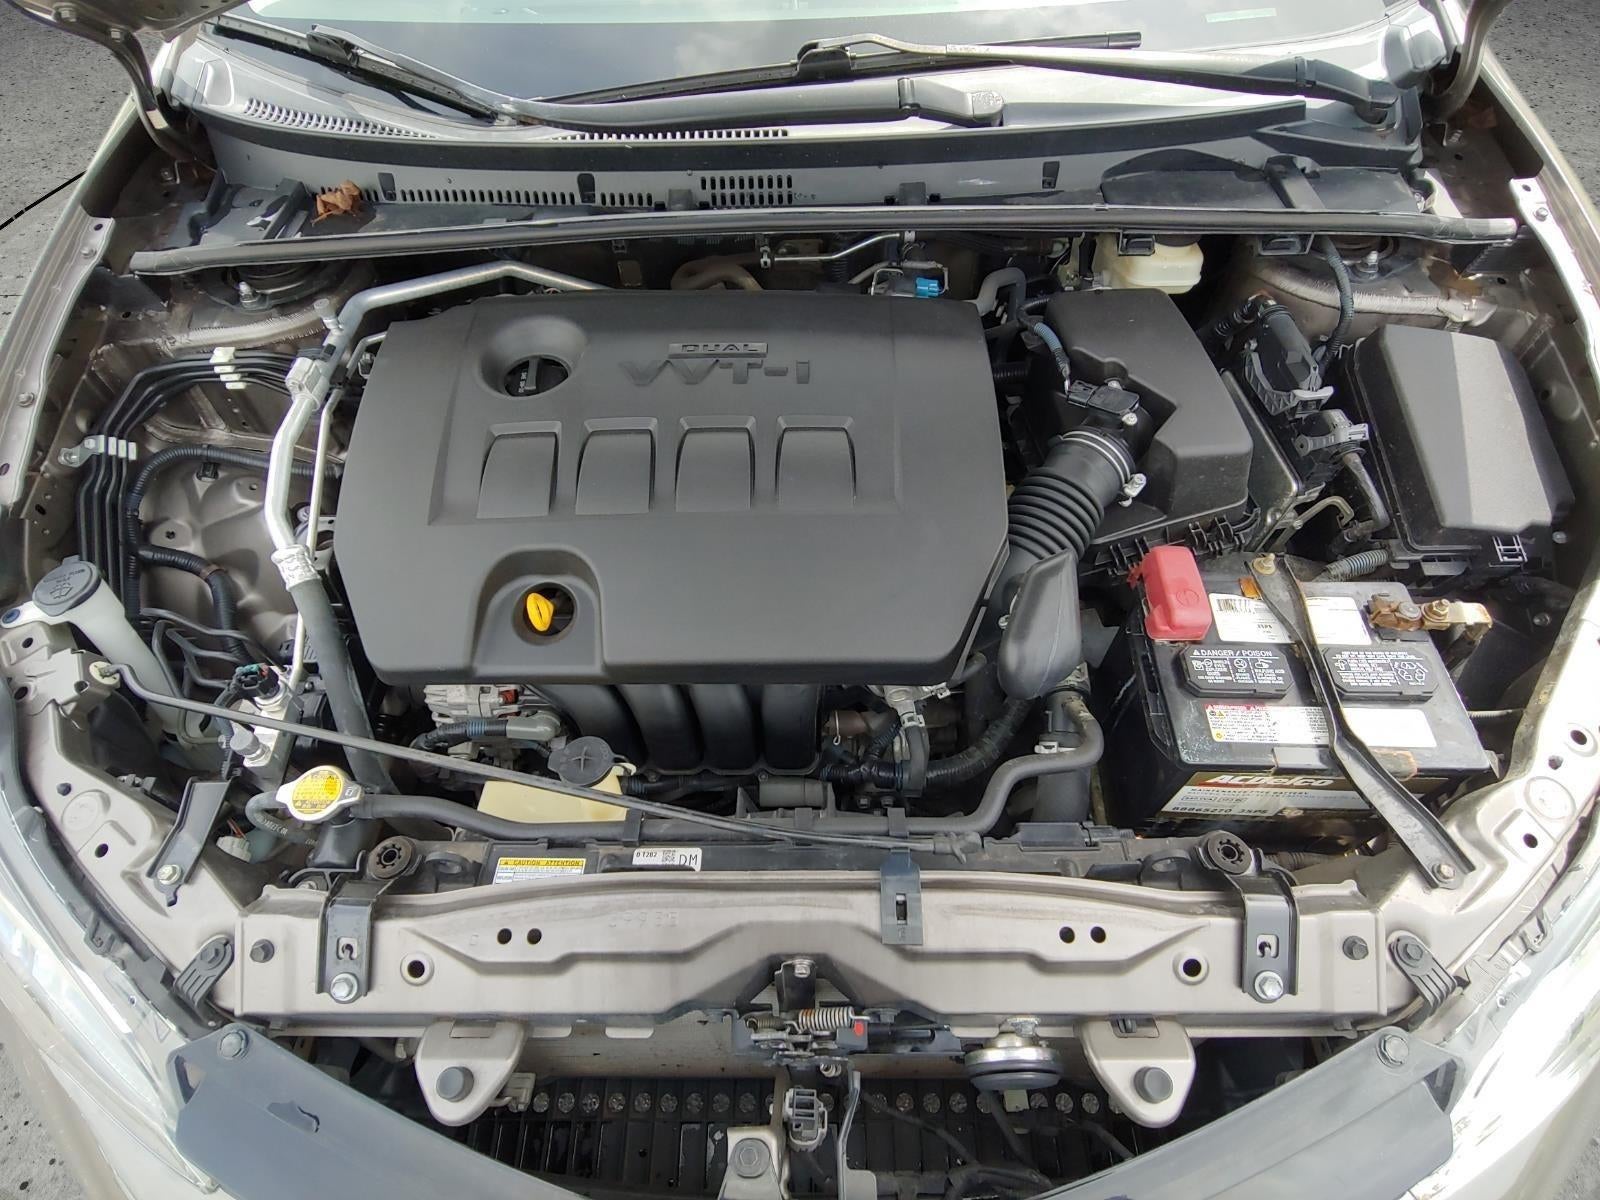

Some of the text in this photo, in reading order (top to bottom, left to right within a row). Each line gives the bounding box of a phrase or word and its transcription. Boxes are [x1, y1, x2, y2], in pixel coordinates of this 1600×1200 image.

[681, 343, 759, 352] DUAL
[1241, 649, 1273, 657] POISON
[1205, 774, 1334, 787] ACDelco
[679, 854, 698, 866] DM
